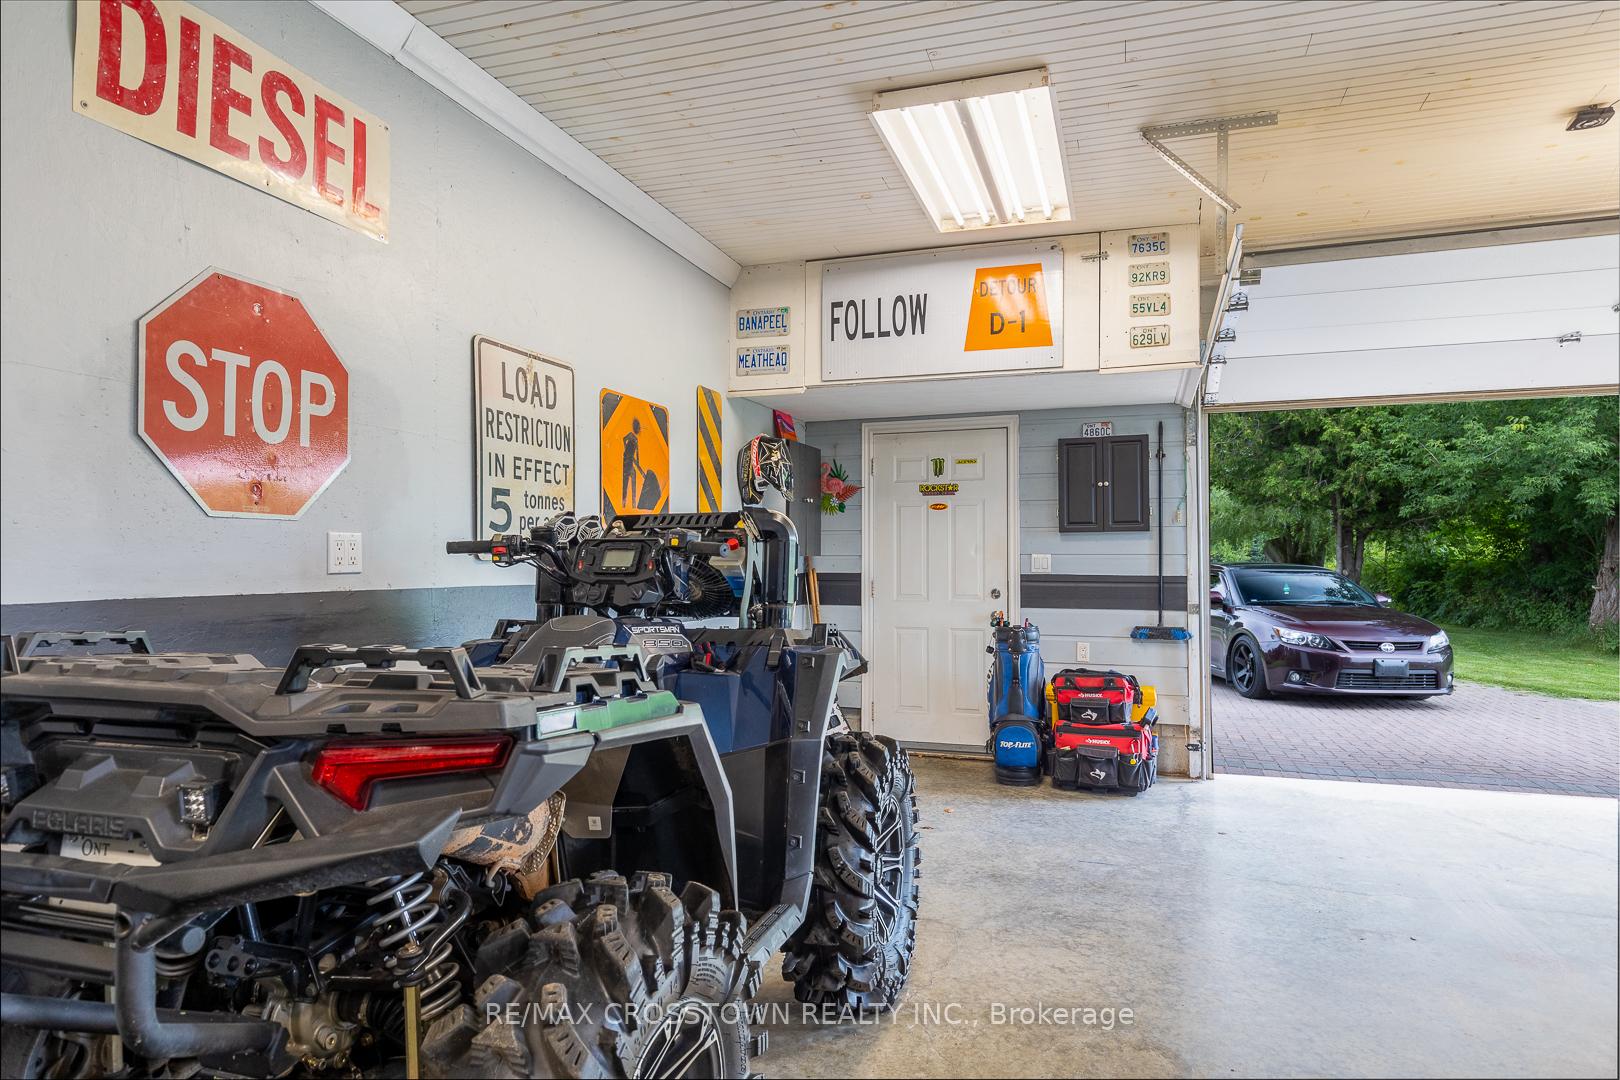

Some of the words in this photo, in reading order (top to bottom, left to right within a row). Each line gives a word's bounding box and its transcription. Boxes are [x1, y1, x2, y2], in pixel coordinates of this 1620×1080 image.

[96, 0, 381, 219] DIESEL
[1132, 241, 1166, 253] 7635C
[979, 277, 1037, 298] DETOUR
[1132, 271, 1166, 283] 92KR9
[830, 293, 928, 342] FOLLOW
[1132, 301, 1166, 314] 55VL4
[739, 314, 787, 331] BANAPEEL
[990, 310, 1026, 336] D-1
[1132, 332, 1167, 346] 629LV
[738, 352, 787, 368] MEATHEAD
[162, 339, 336, 448] STOP
[501, 361, 557, 410] LOAD
[485, 407, 571, 453] RESTRICTION
[488, 452, 505, 478] IN
[513, 455, 570, 486] EFFECT
[488, 487, 512, 533] 5
[523, 490, 565, 511] tonnes
[631, 625, 680, 634] SPORTSMAN
[643, 638, 683, 648] 850
[32, 808, 125, 837] POLARIS
[81, 838, 111, 857] ONT
